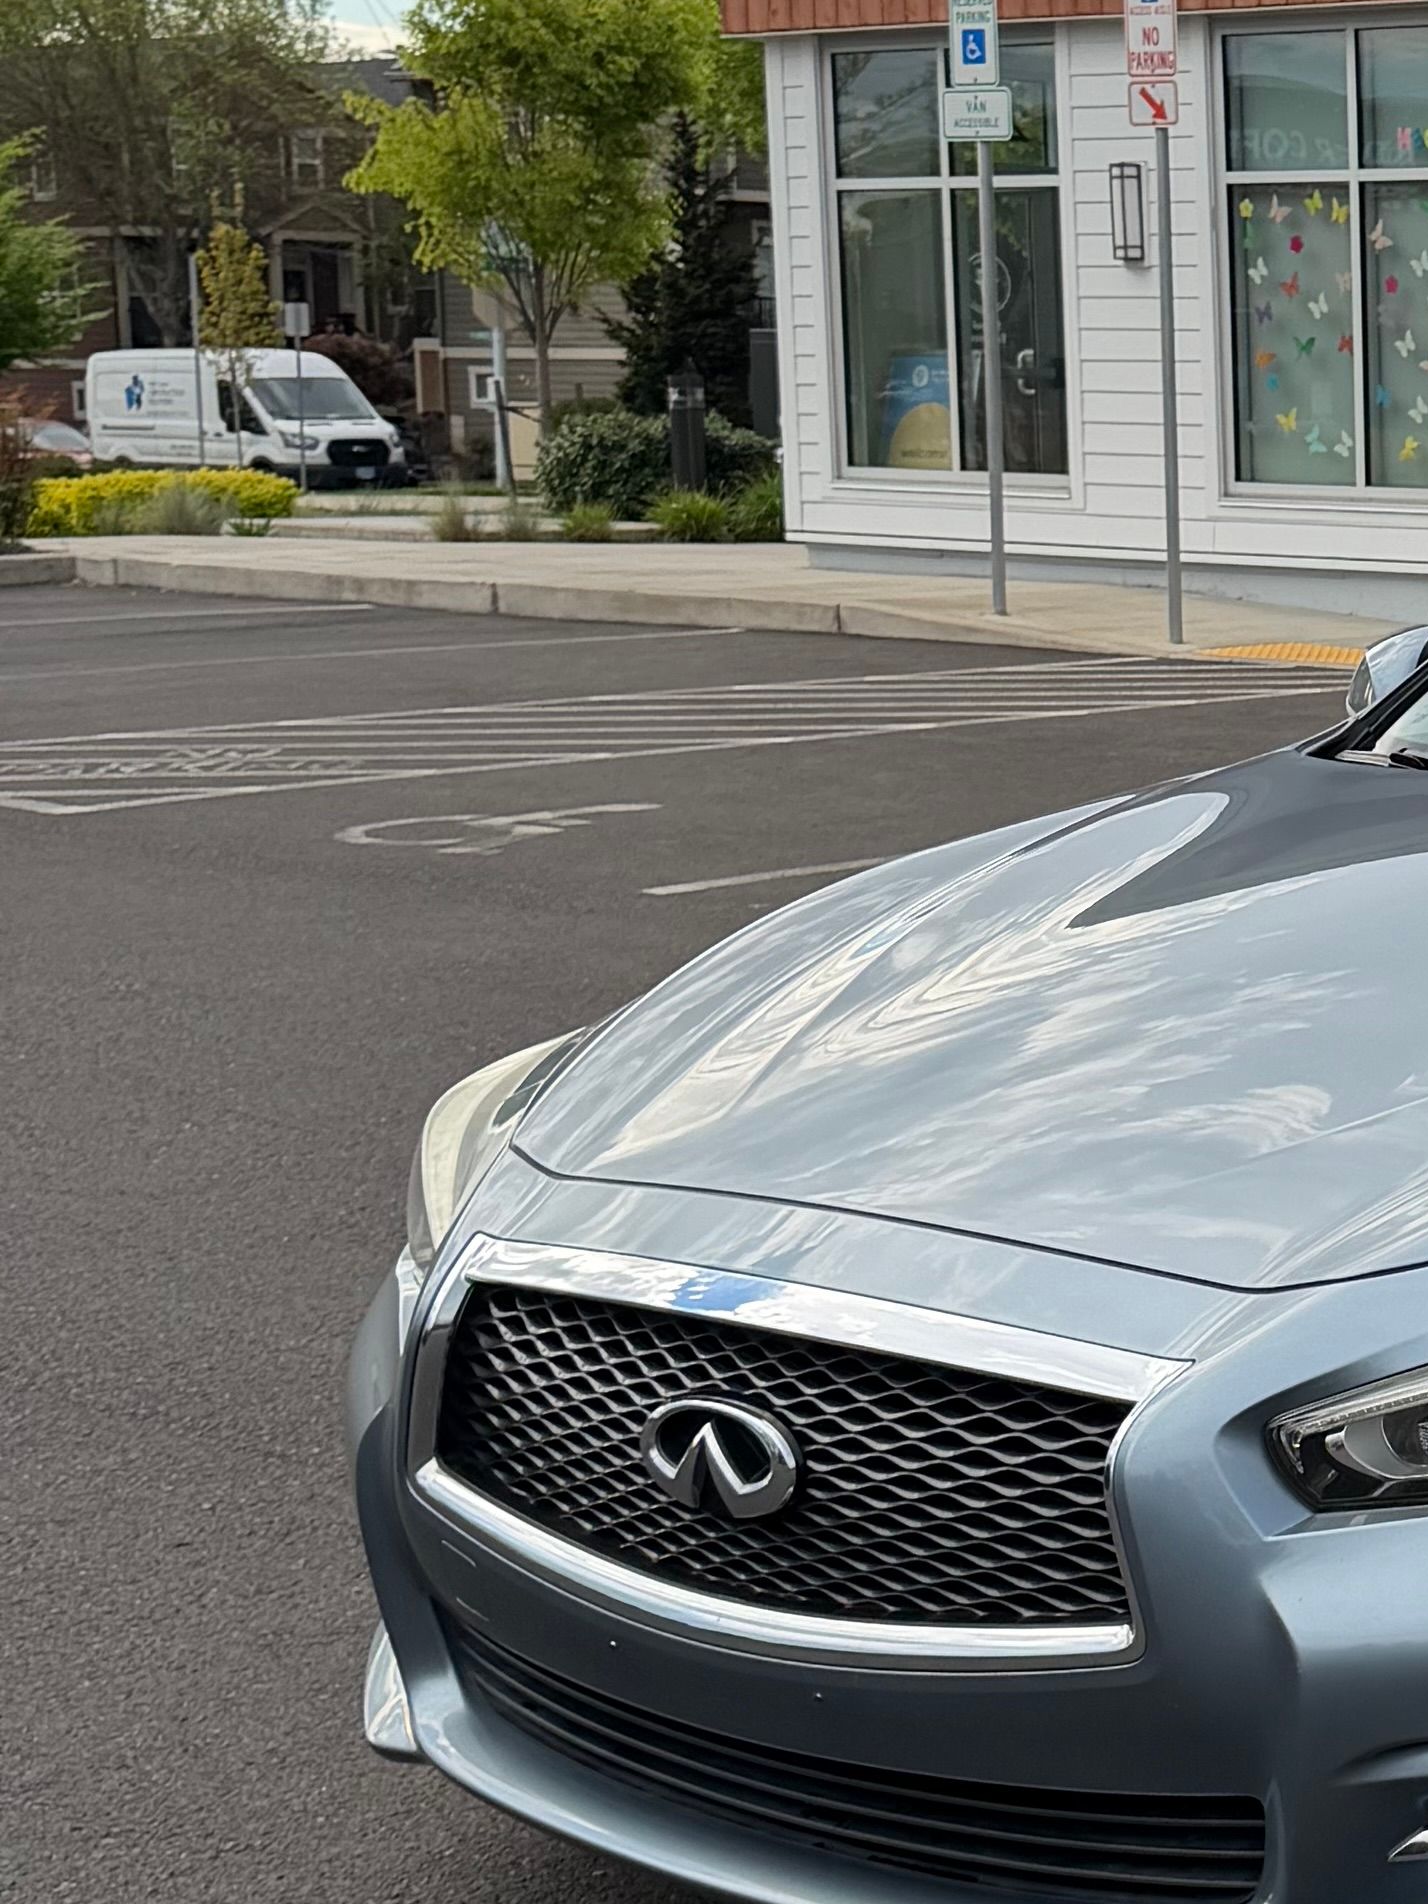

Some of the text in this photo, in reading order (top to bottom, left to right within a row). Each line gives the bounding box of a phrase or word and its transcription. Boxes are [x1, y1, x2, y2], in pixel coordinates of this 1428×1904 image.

[955, 10, 991, 24] PARKING
[1142, 26, 1159, 46] NO
[1129, 51, 1175, 70] PARKING
[966, 100, 987, 113] VAN
